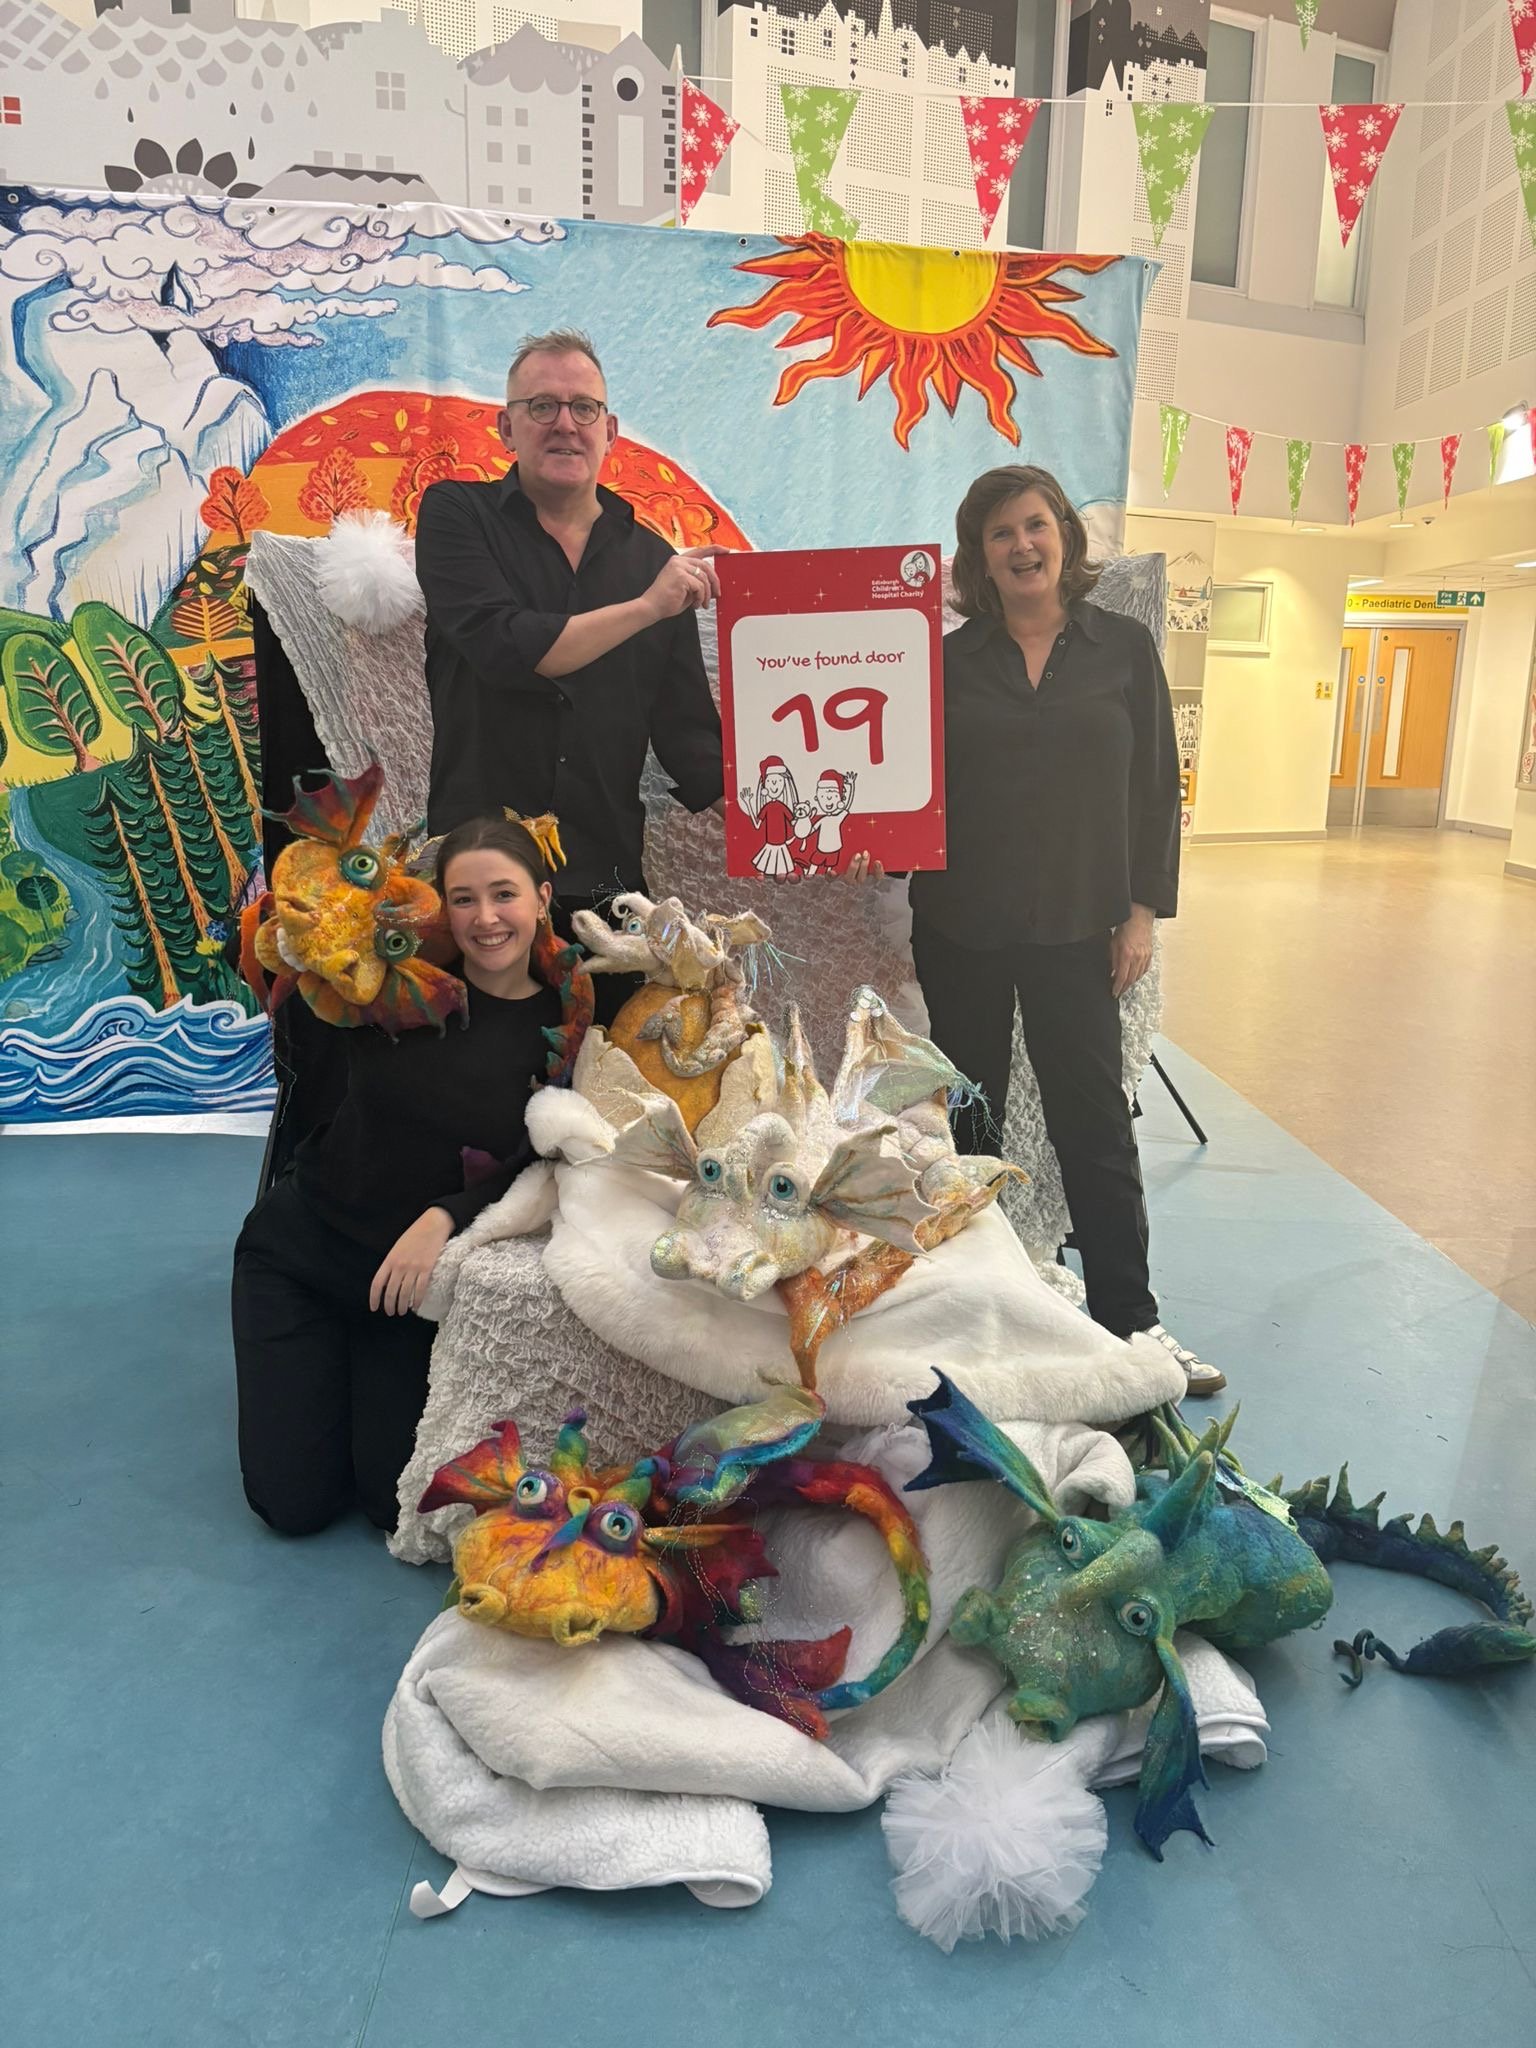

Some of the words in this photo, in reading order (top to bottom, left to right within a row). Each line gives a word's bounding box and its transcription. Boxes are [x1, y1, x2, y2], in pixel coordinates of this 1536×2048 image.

[900, 590, 924, 598] Charity
[1362, 598, 1411, 608] Paediatric
[1413, 600, 1446, 609] Dent
[756, 656, 811, 671] You've
[814, 651, 862, 670] found
[865, 651, 905, 664] door
[771, 687, 889, 765] 19
